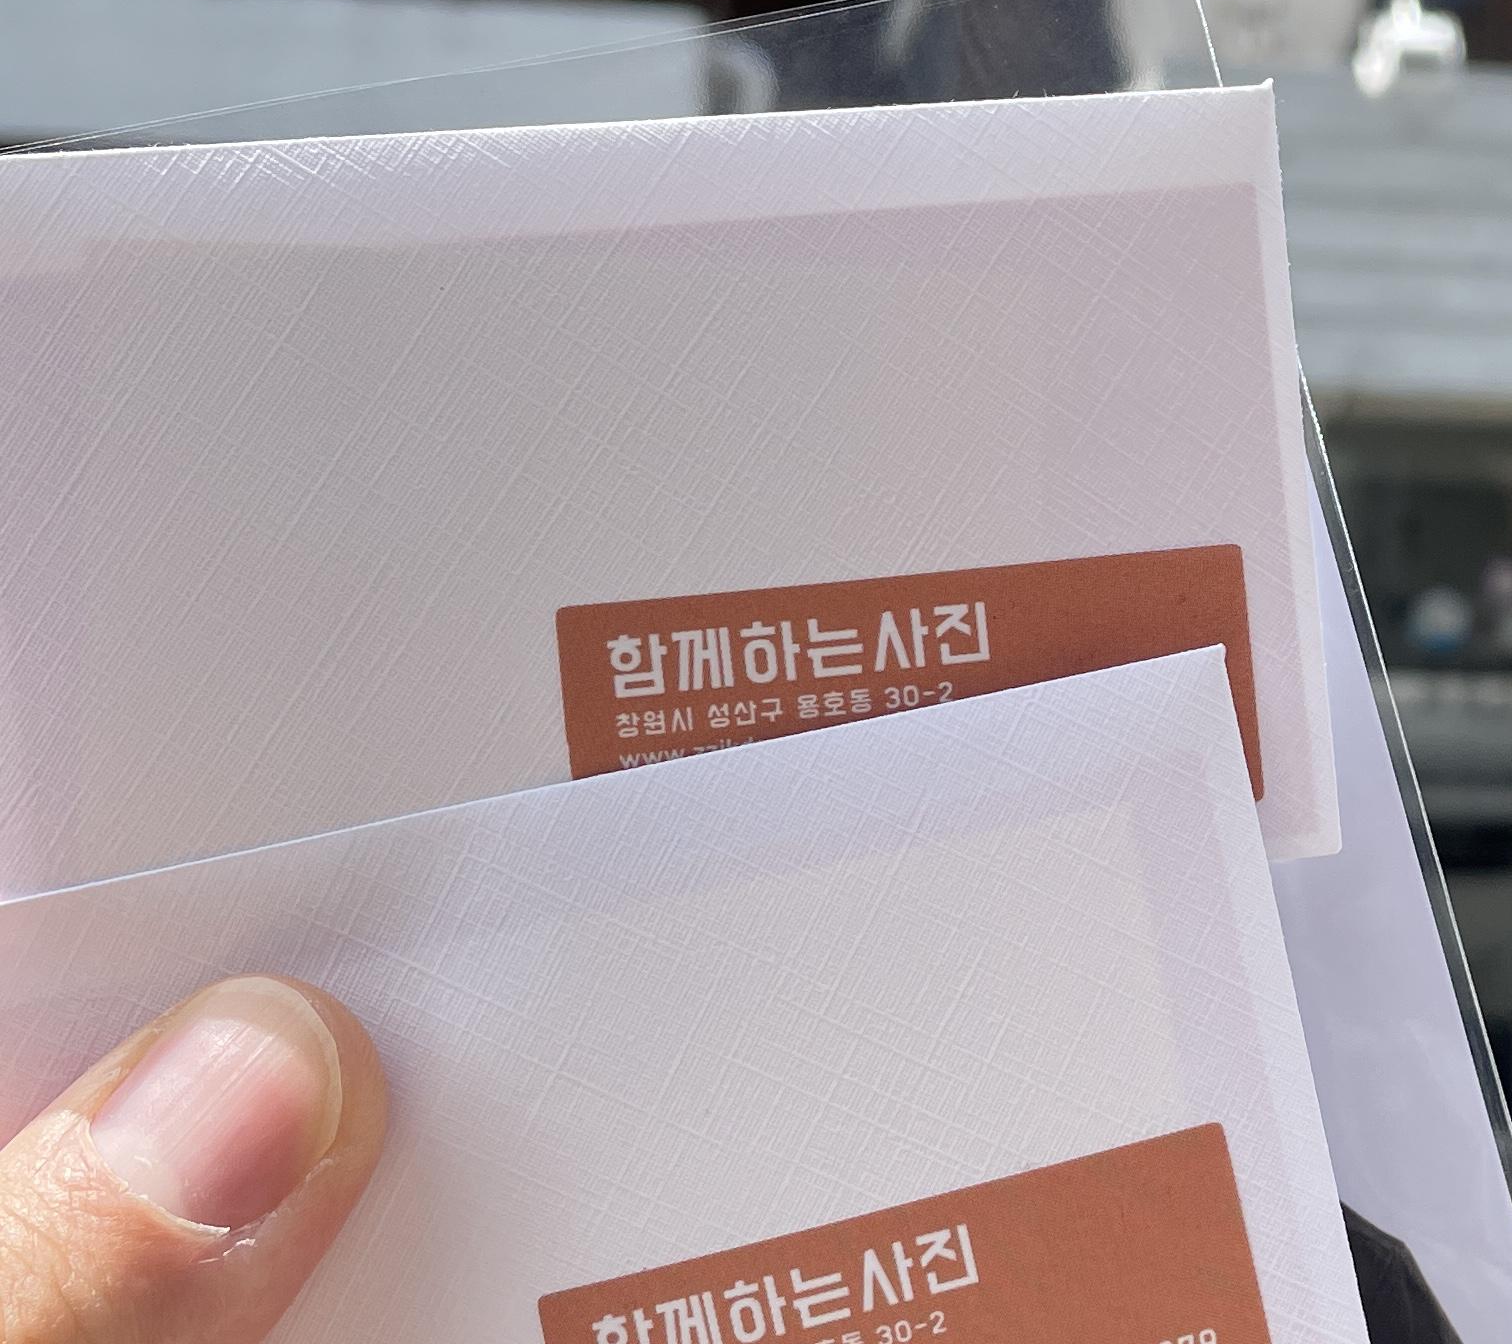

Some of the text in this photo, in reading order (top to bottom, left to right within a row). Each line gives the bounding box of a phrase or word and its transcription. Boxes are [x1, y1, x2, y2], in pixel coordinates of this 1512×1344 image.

[606, 601, 991, 699] 함께하는사진
[615, 681, 953, 739] 창원시 성산구 용호동 30-2
